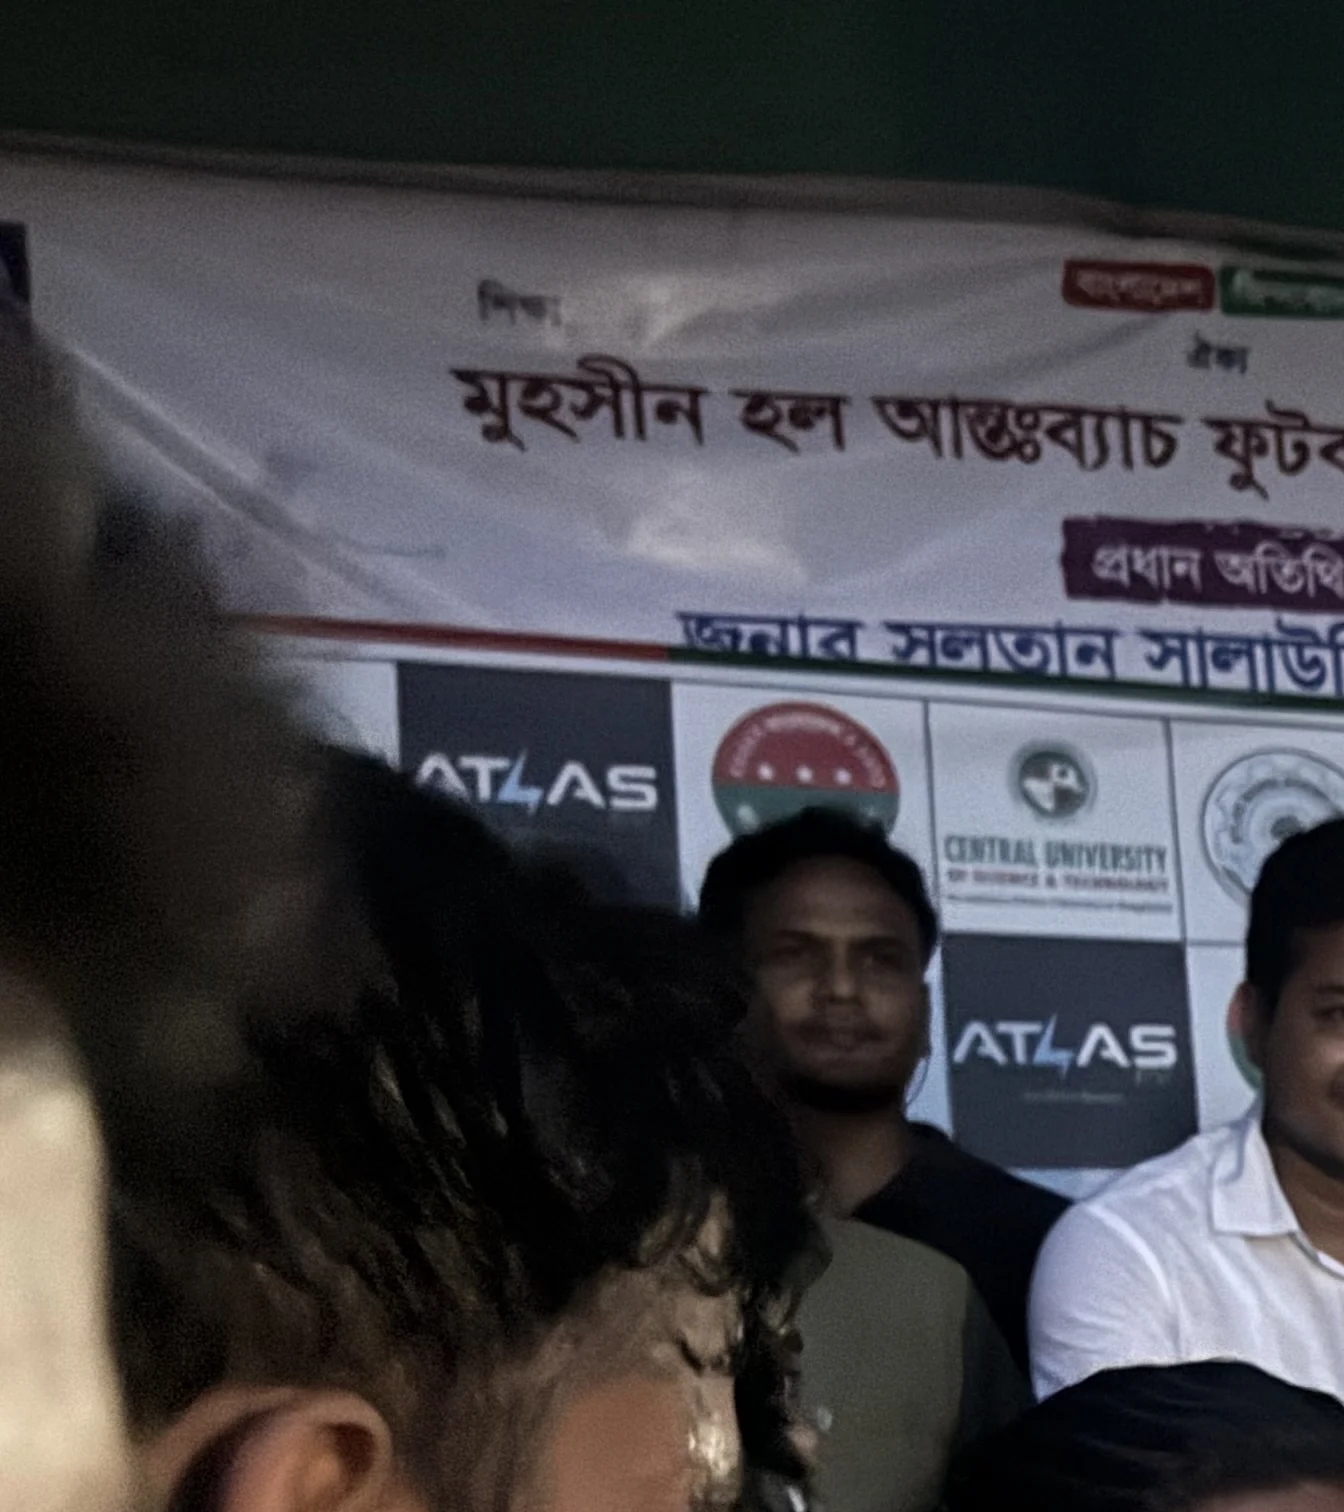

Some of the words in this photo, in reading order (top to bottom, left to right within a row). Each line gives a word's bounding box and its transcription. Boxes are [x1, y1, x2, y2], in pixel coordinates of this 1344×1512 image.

[450, 354, 709, 451] মুহসীন
[728, 388, 851, 453] হল
[1092, 545, 1200, 590] প্রধান
[414, 750, 659, 817] ATLAS
[944, 833, 1040, 867] CENTRAL
[1045, 840, 1168, 875] UNIVERSITY
[953, 1012, 1178, 1081] ATLAS
